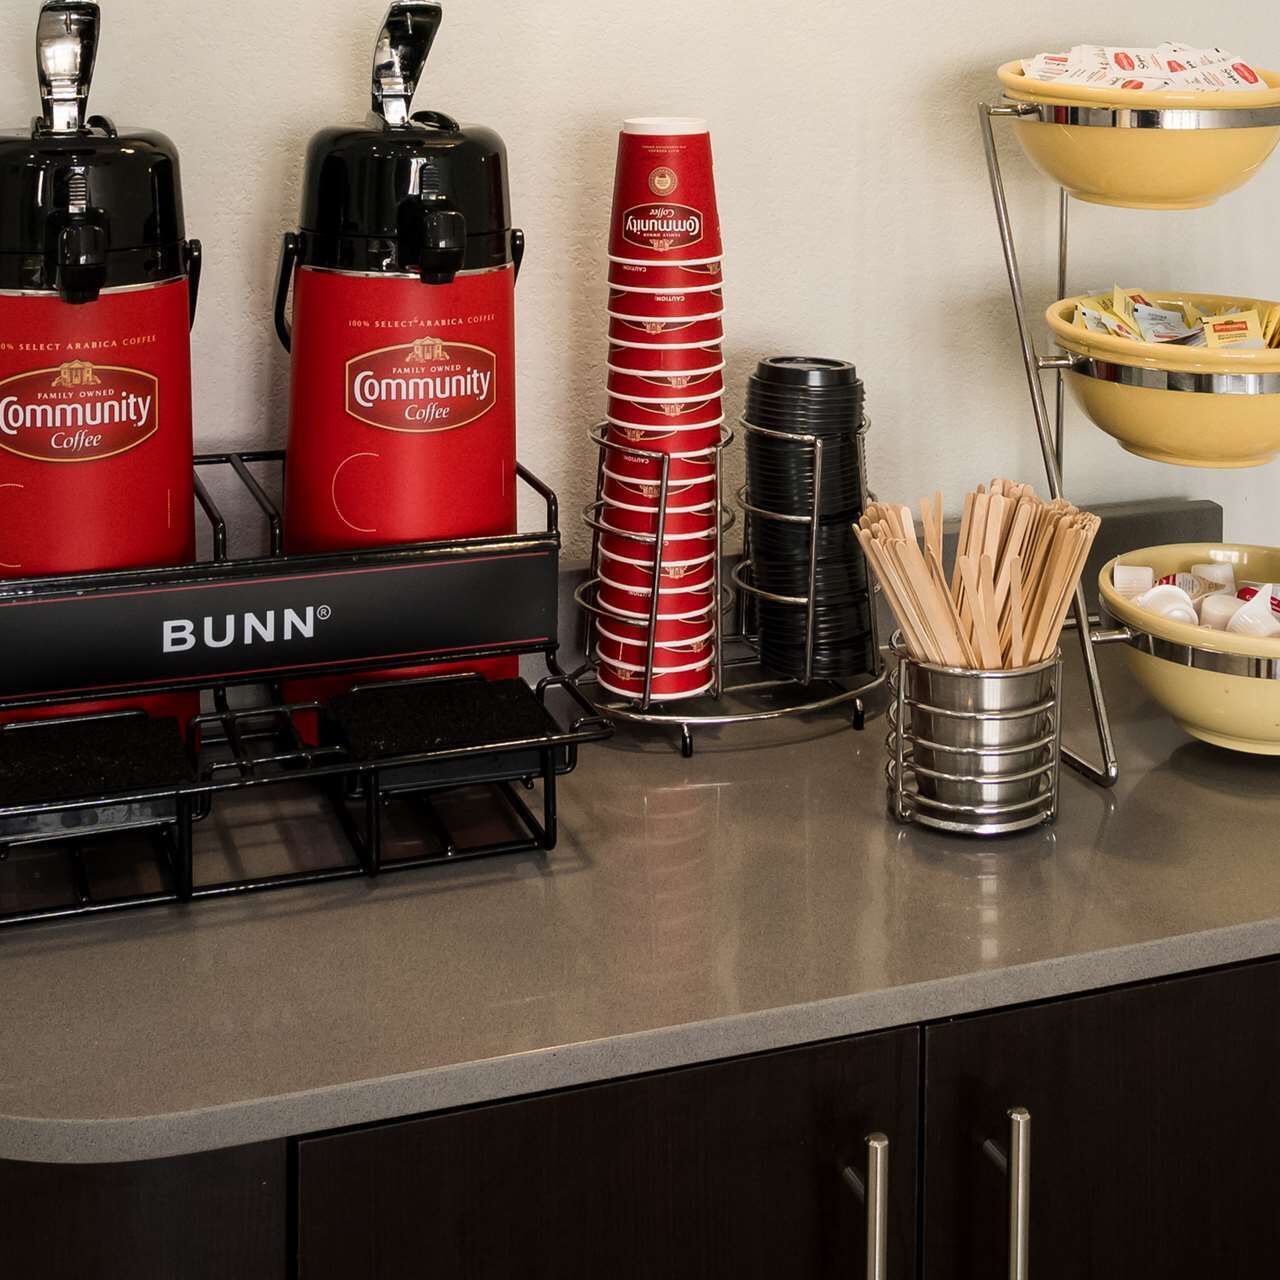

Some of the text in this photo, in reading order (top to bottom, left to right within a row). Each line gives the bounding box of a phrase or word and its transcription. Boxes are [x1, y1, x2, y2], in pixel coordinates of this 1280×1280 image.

[649, 207, 675, 218] Coffee
[625, 215, 700, 236] Community
[348, 314, 496, 328] 100% SELECT ARABICA COFFEE
[19, 343, 61, 351] SELECT
[66, 340, 117, 351] ARABICA
[122, 334, 157, 346] COFFEE
[430, 364, 461, 373] OWNED
[37, 389, 115, 400] FAMILY OWNED
[353, 366, 491, 407] Community
[404, 402, 450, 424] Coffee
[50, 429, 102, 453] Coffee
